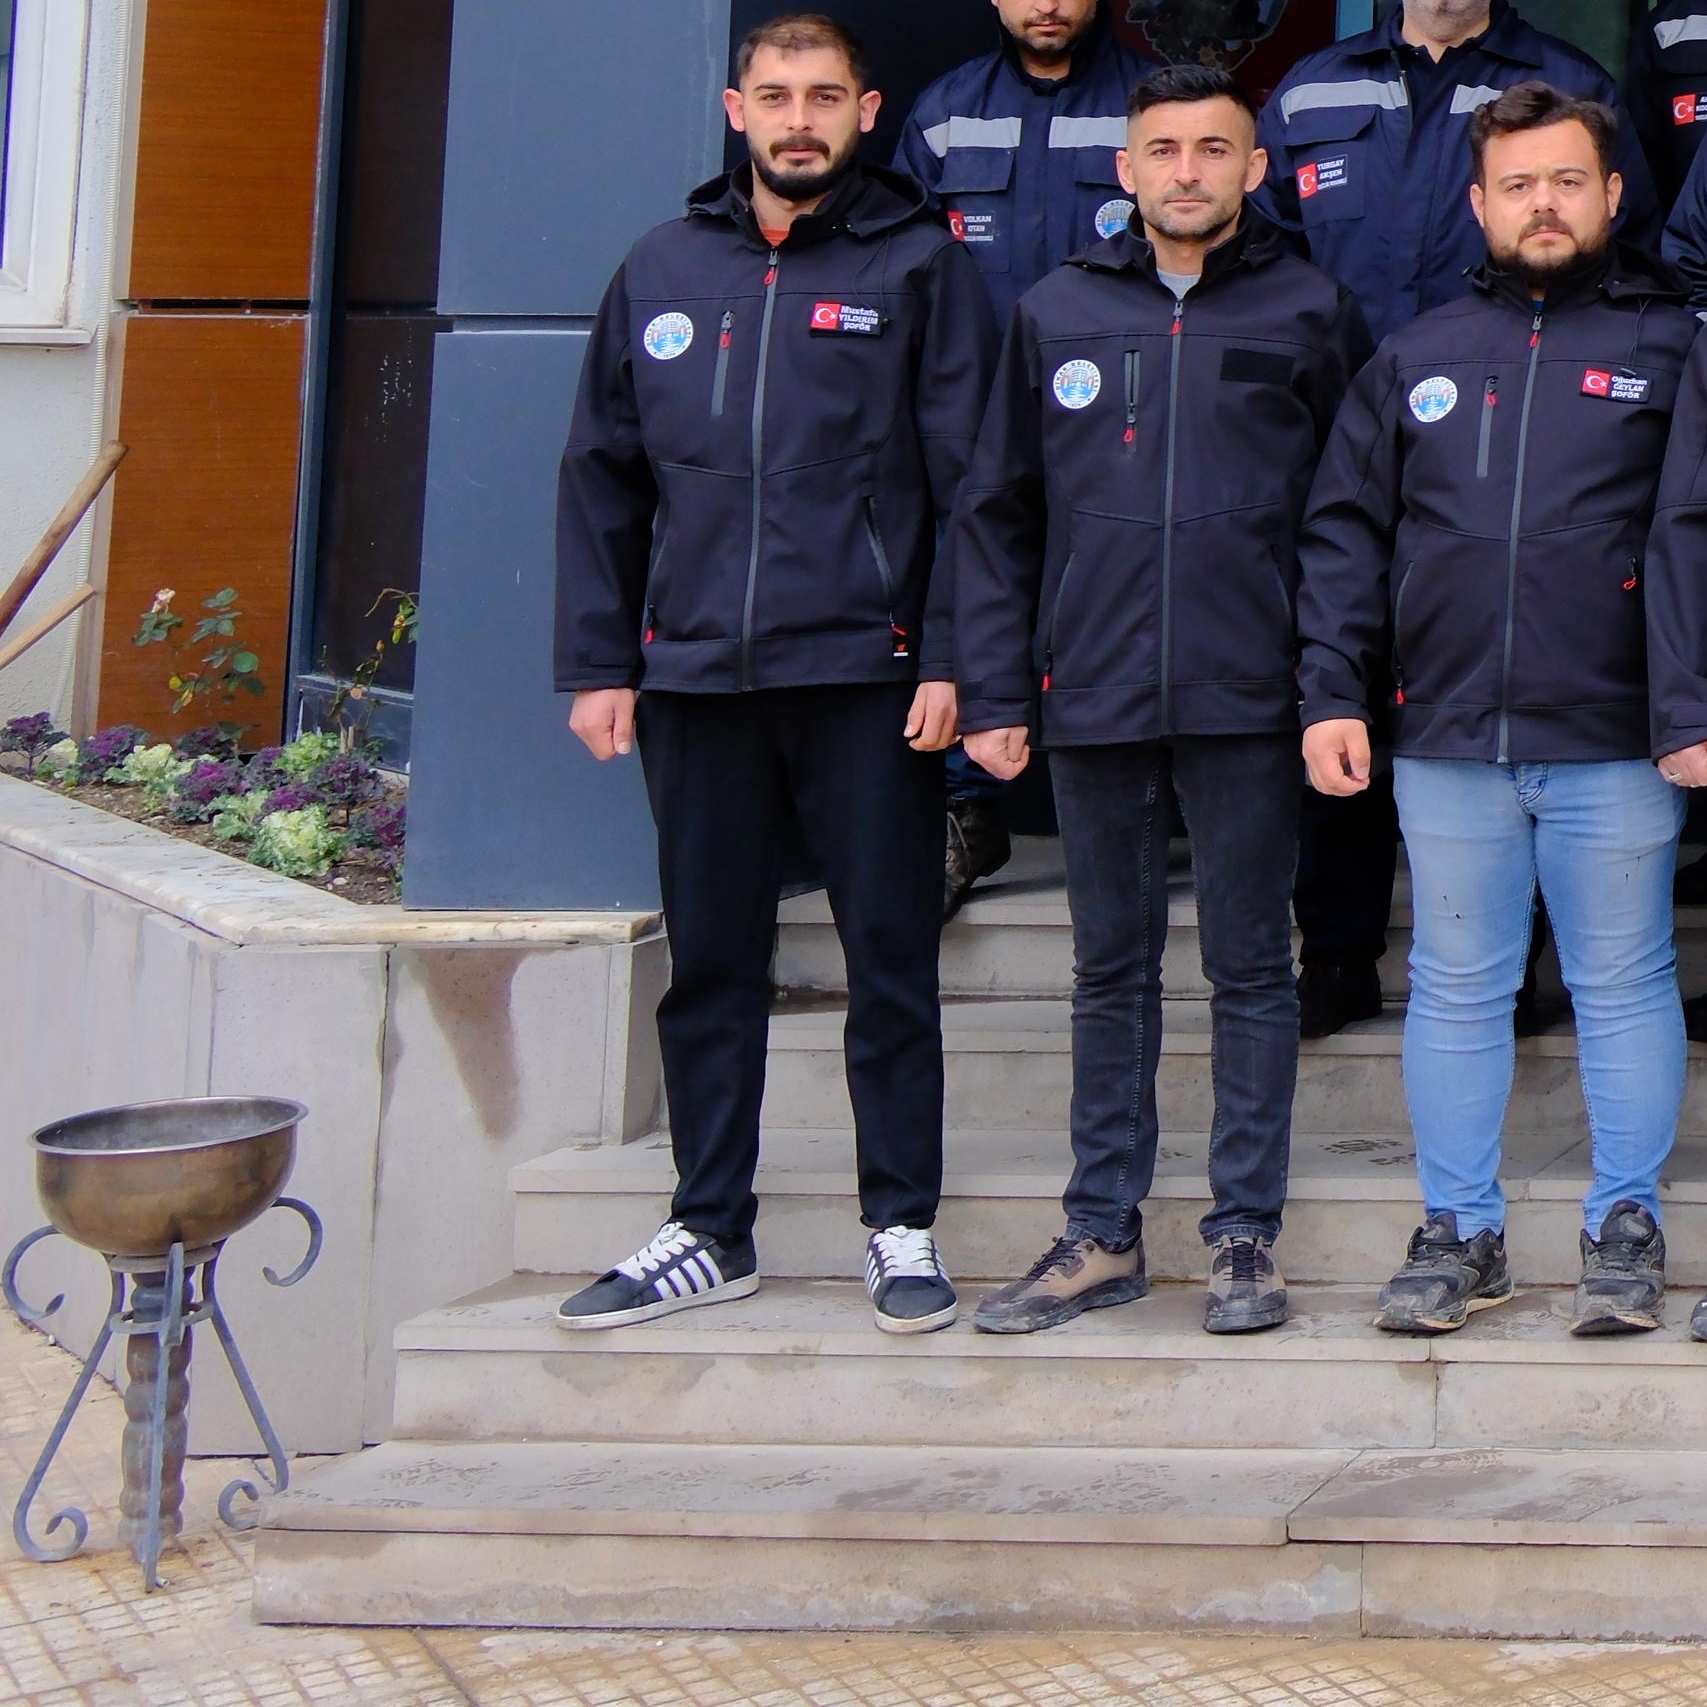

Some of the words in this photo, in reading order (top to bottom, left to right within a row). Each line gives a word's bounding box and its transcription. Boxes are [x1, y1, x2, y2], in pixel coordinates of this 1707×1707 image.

[841, 305, 879, 317] Mustafa
[839, 314, 879, 325] YILDIRIM
[843, 322, 871, 332] ŞOFÖR
[1611, 390, 1640, 399] ŞOFÖR
